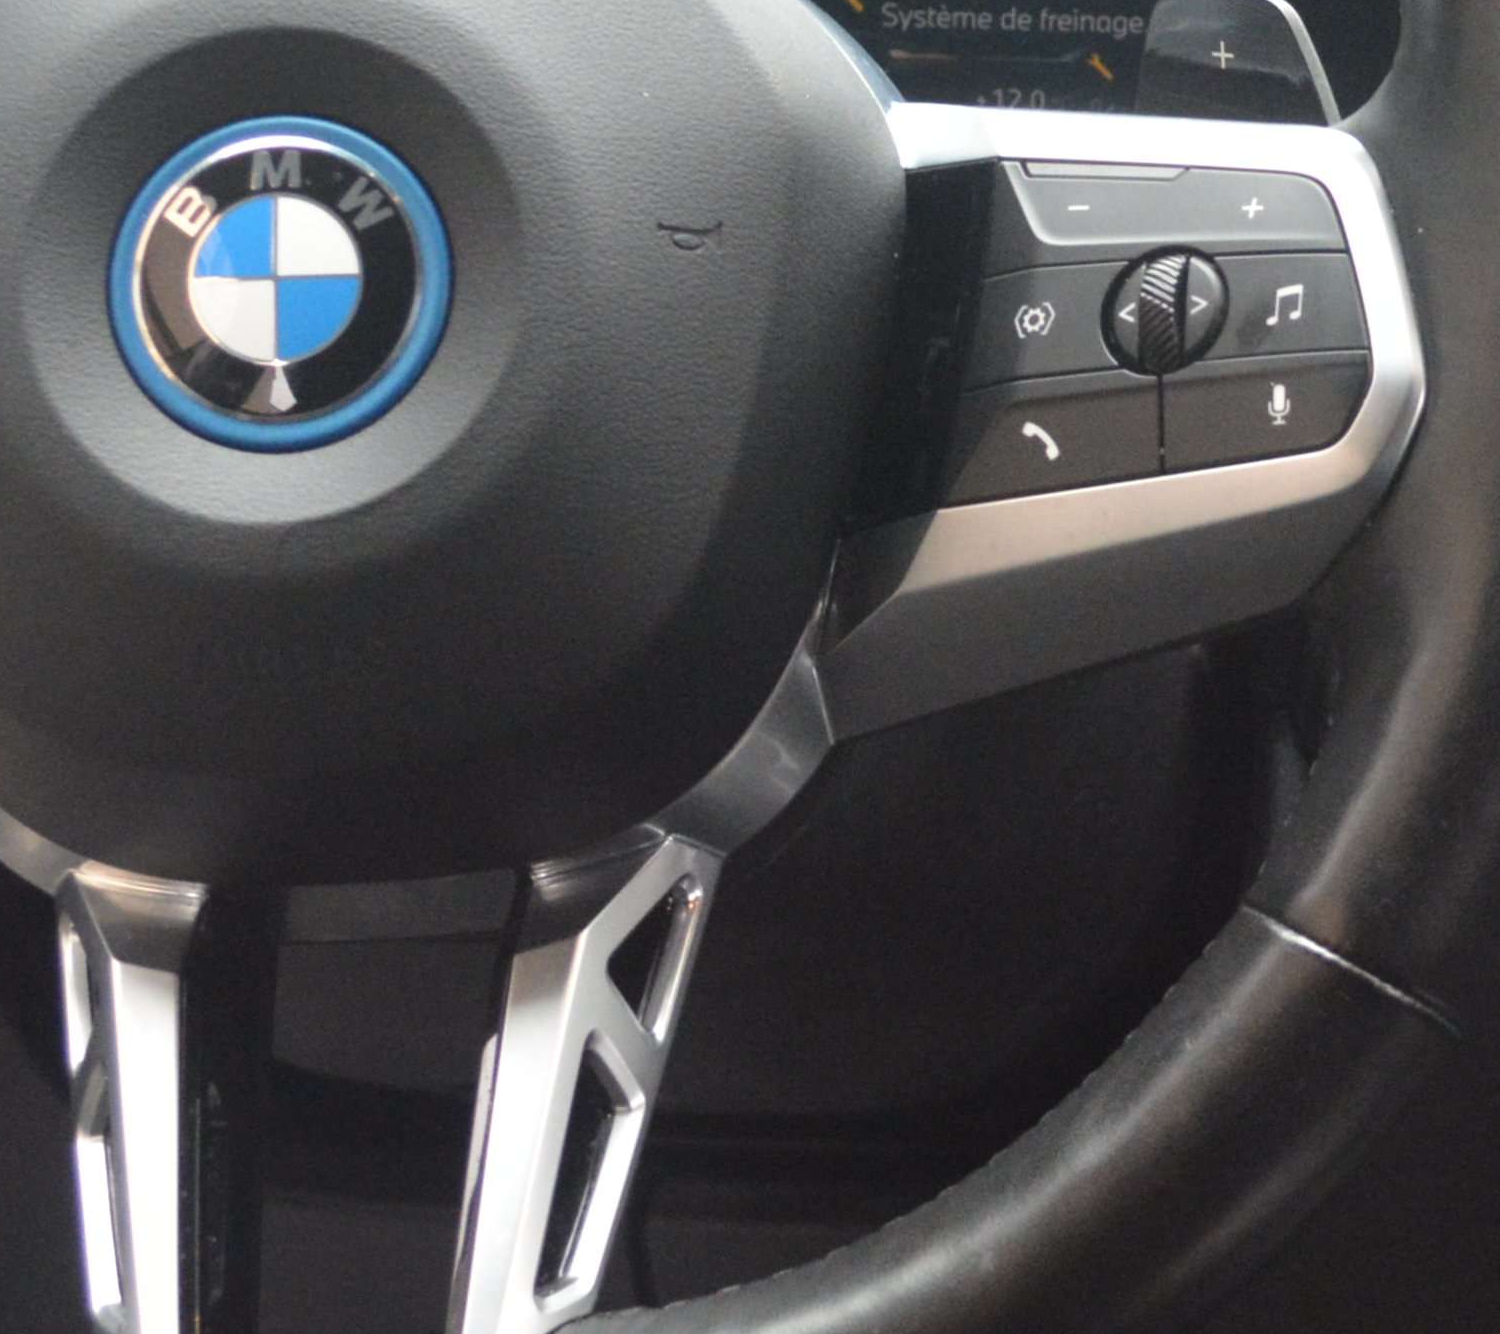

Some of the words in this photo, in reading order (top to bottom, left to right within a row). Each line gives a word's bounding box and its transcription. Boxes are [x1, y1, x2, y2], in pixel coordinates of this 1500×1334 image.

[881, 2, 993, 32] Système
[1000, 7, 1032, 31] de
[163, 150, 394, 238] BMW
